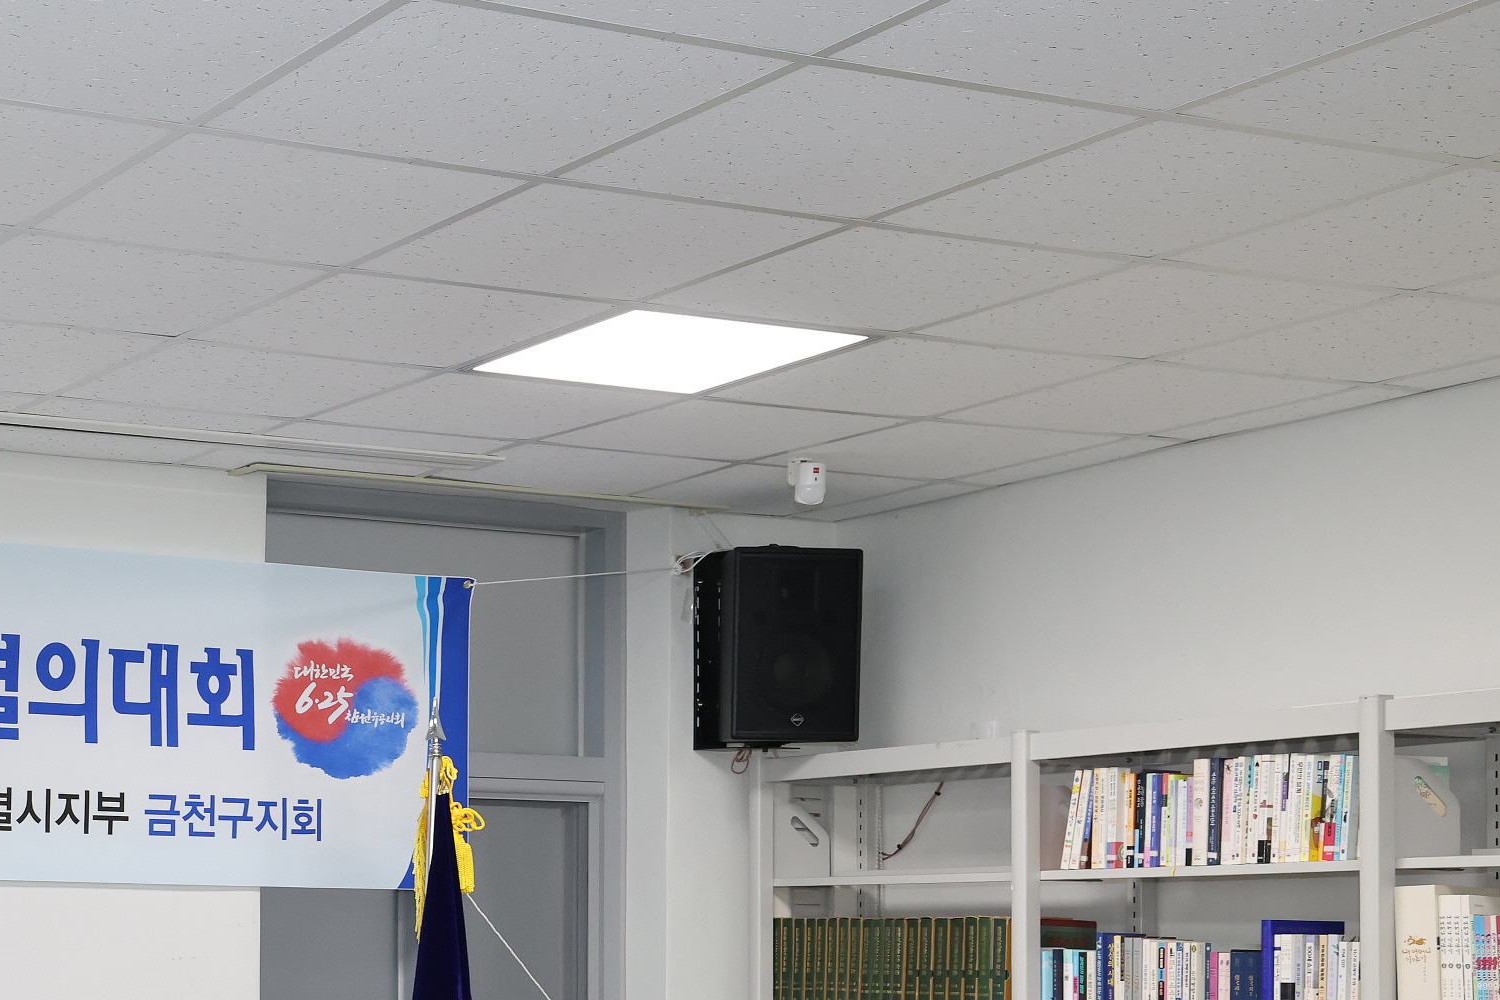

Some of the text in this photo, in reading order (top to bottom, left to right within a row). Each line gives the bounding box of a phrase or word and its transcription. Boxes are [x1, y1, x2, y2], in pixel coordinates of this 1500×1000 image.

[293, 660, 354, 682] 대한민국
[344, 708, 406, 729] 참전유공자회
[144, 793, 324, 842] 금천구지회
